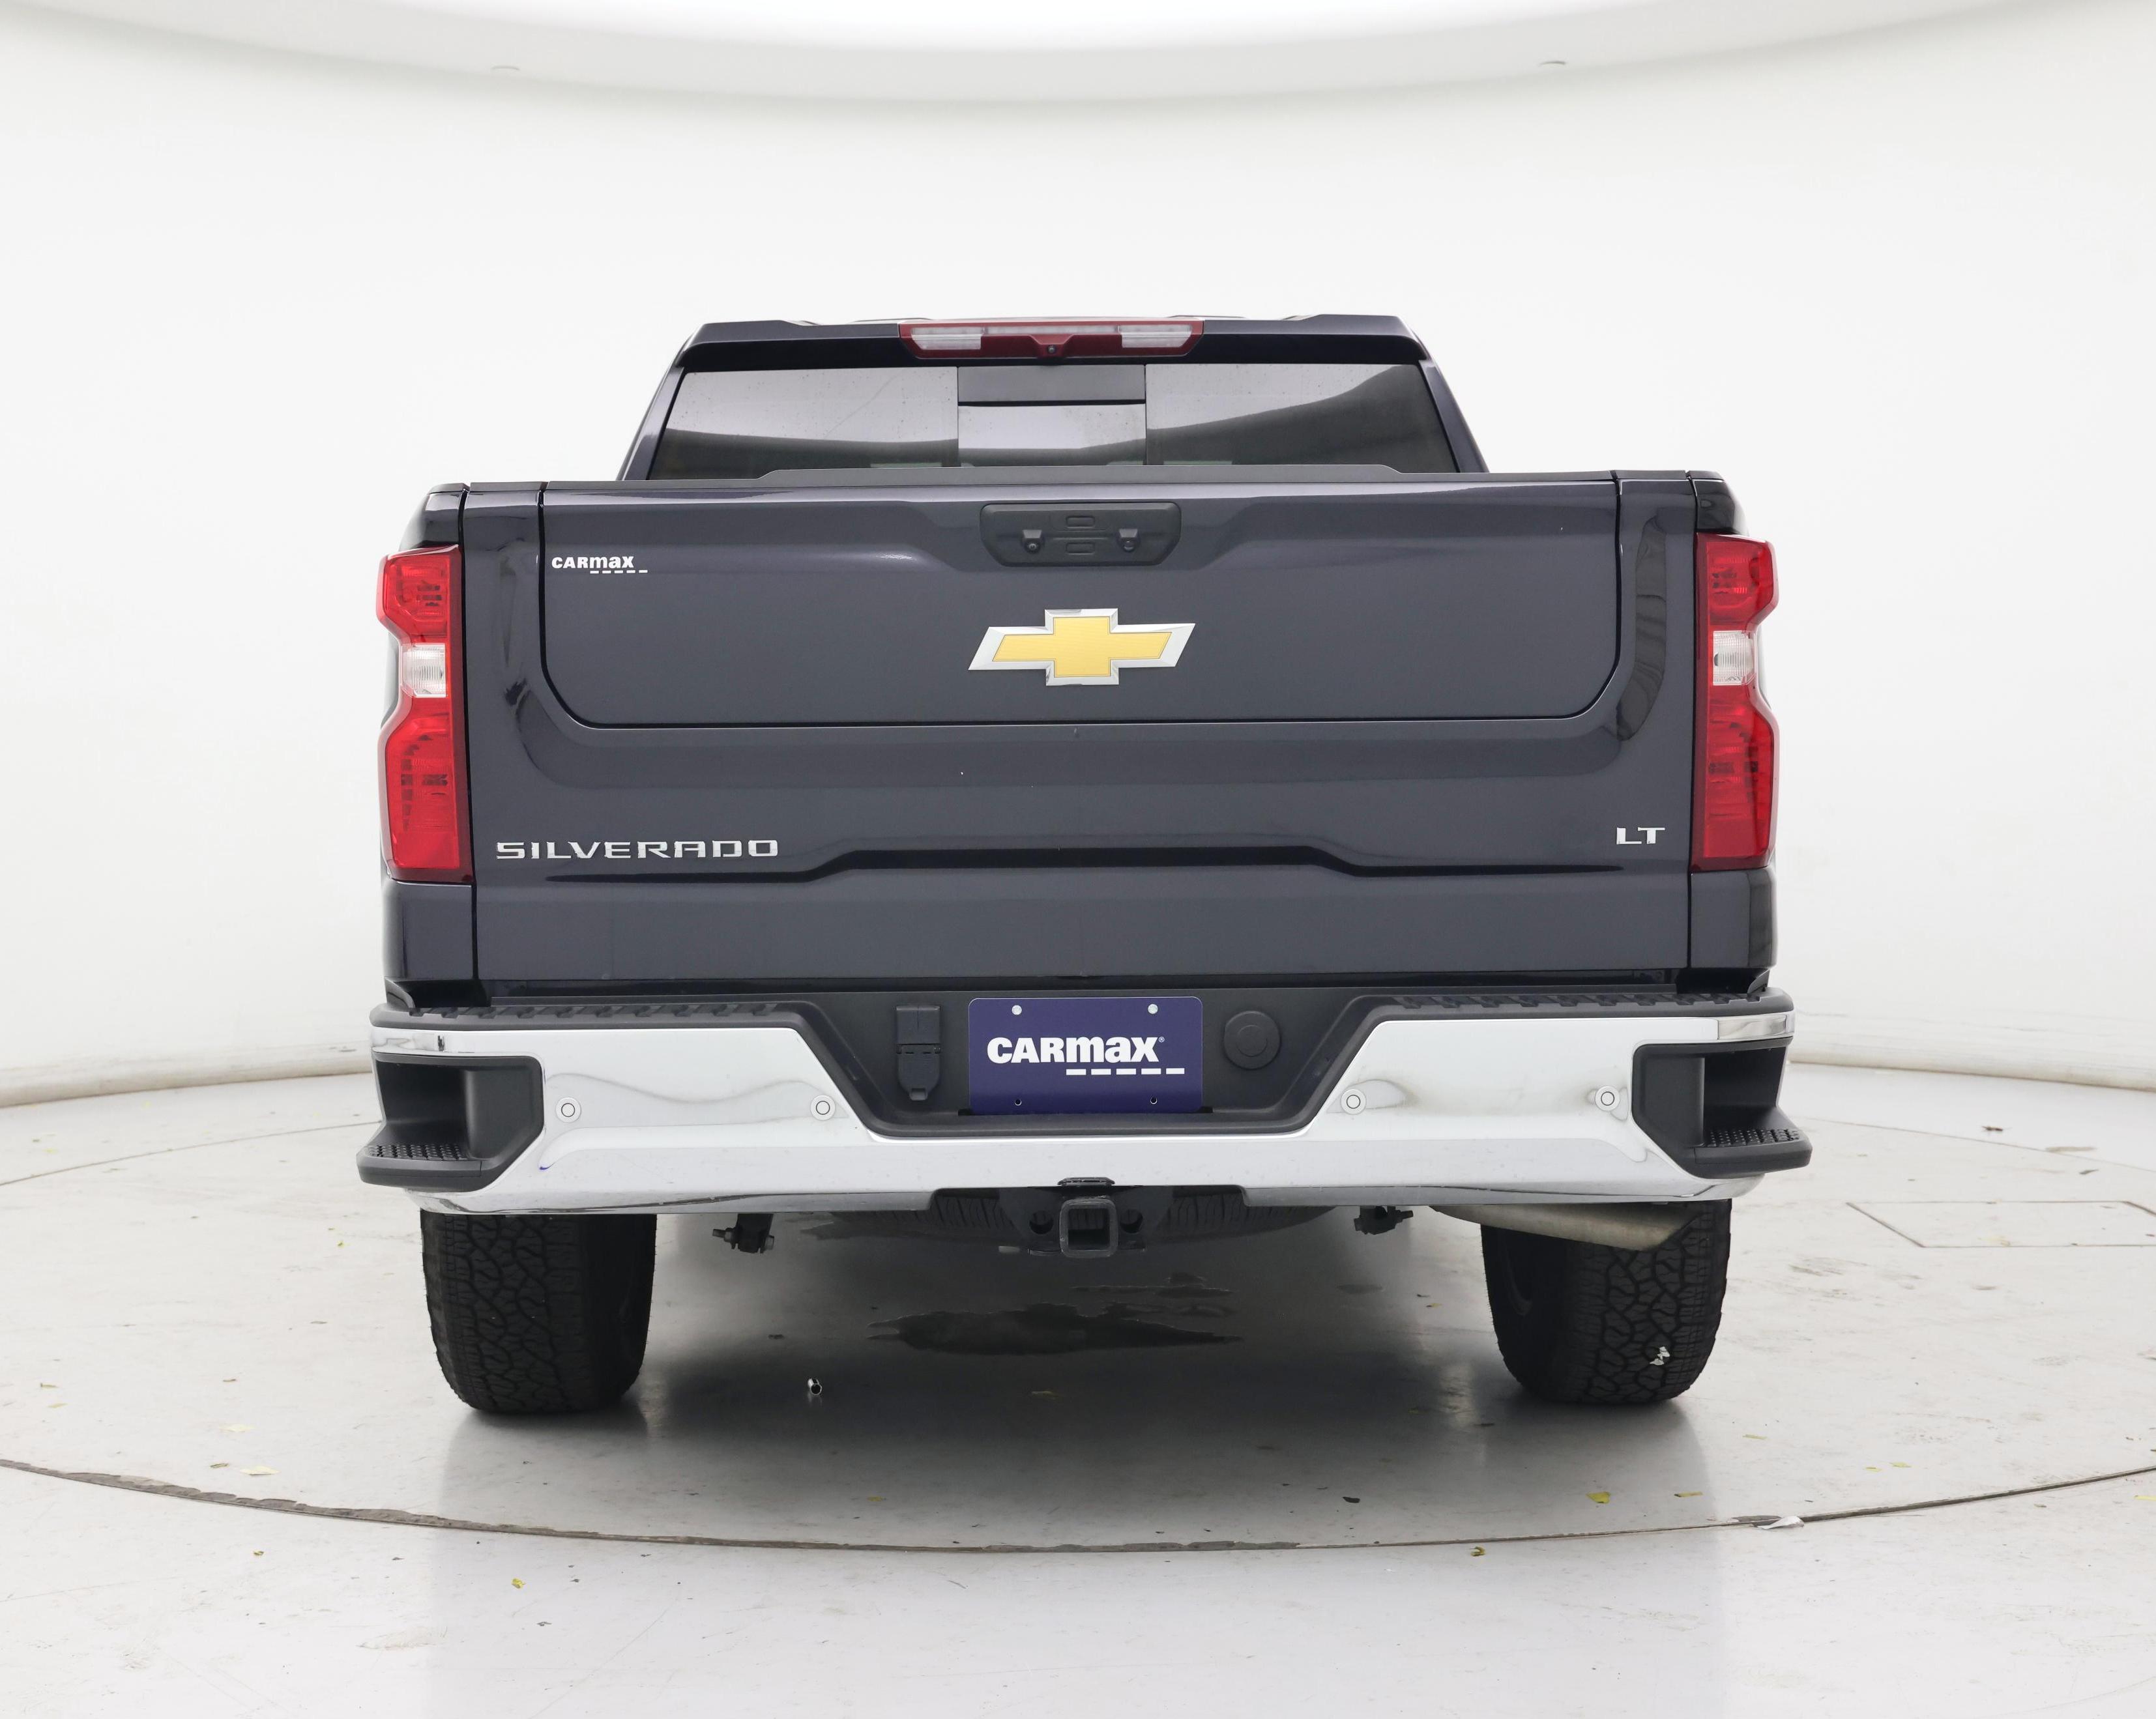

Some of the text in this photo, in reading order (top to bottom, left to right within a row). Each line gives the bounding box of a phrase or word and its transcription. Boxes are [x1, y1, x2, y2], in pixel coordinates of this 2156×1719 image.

[551, 556, 634, 569] CARmax
[1616, 827, 1665, 845] LT
[497, 840, 778, 860] SILVERADO
